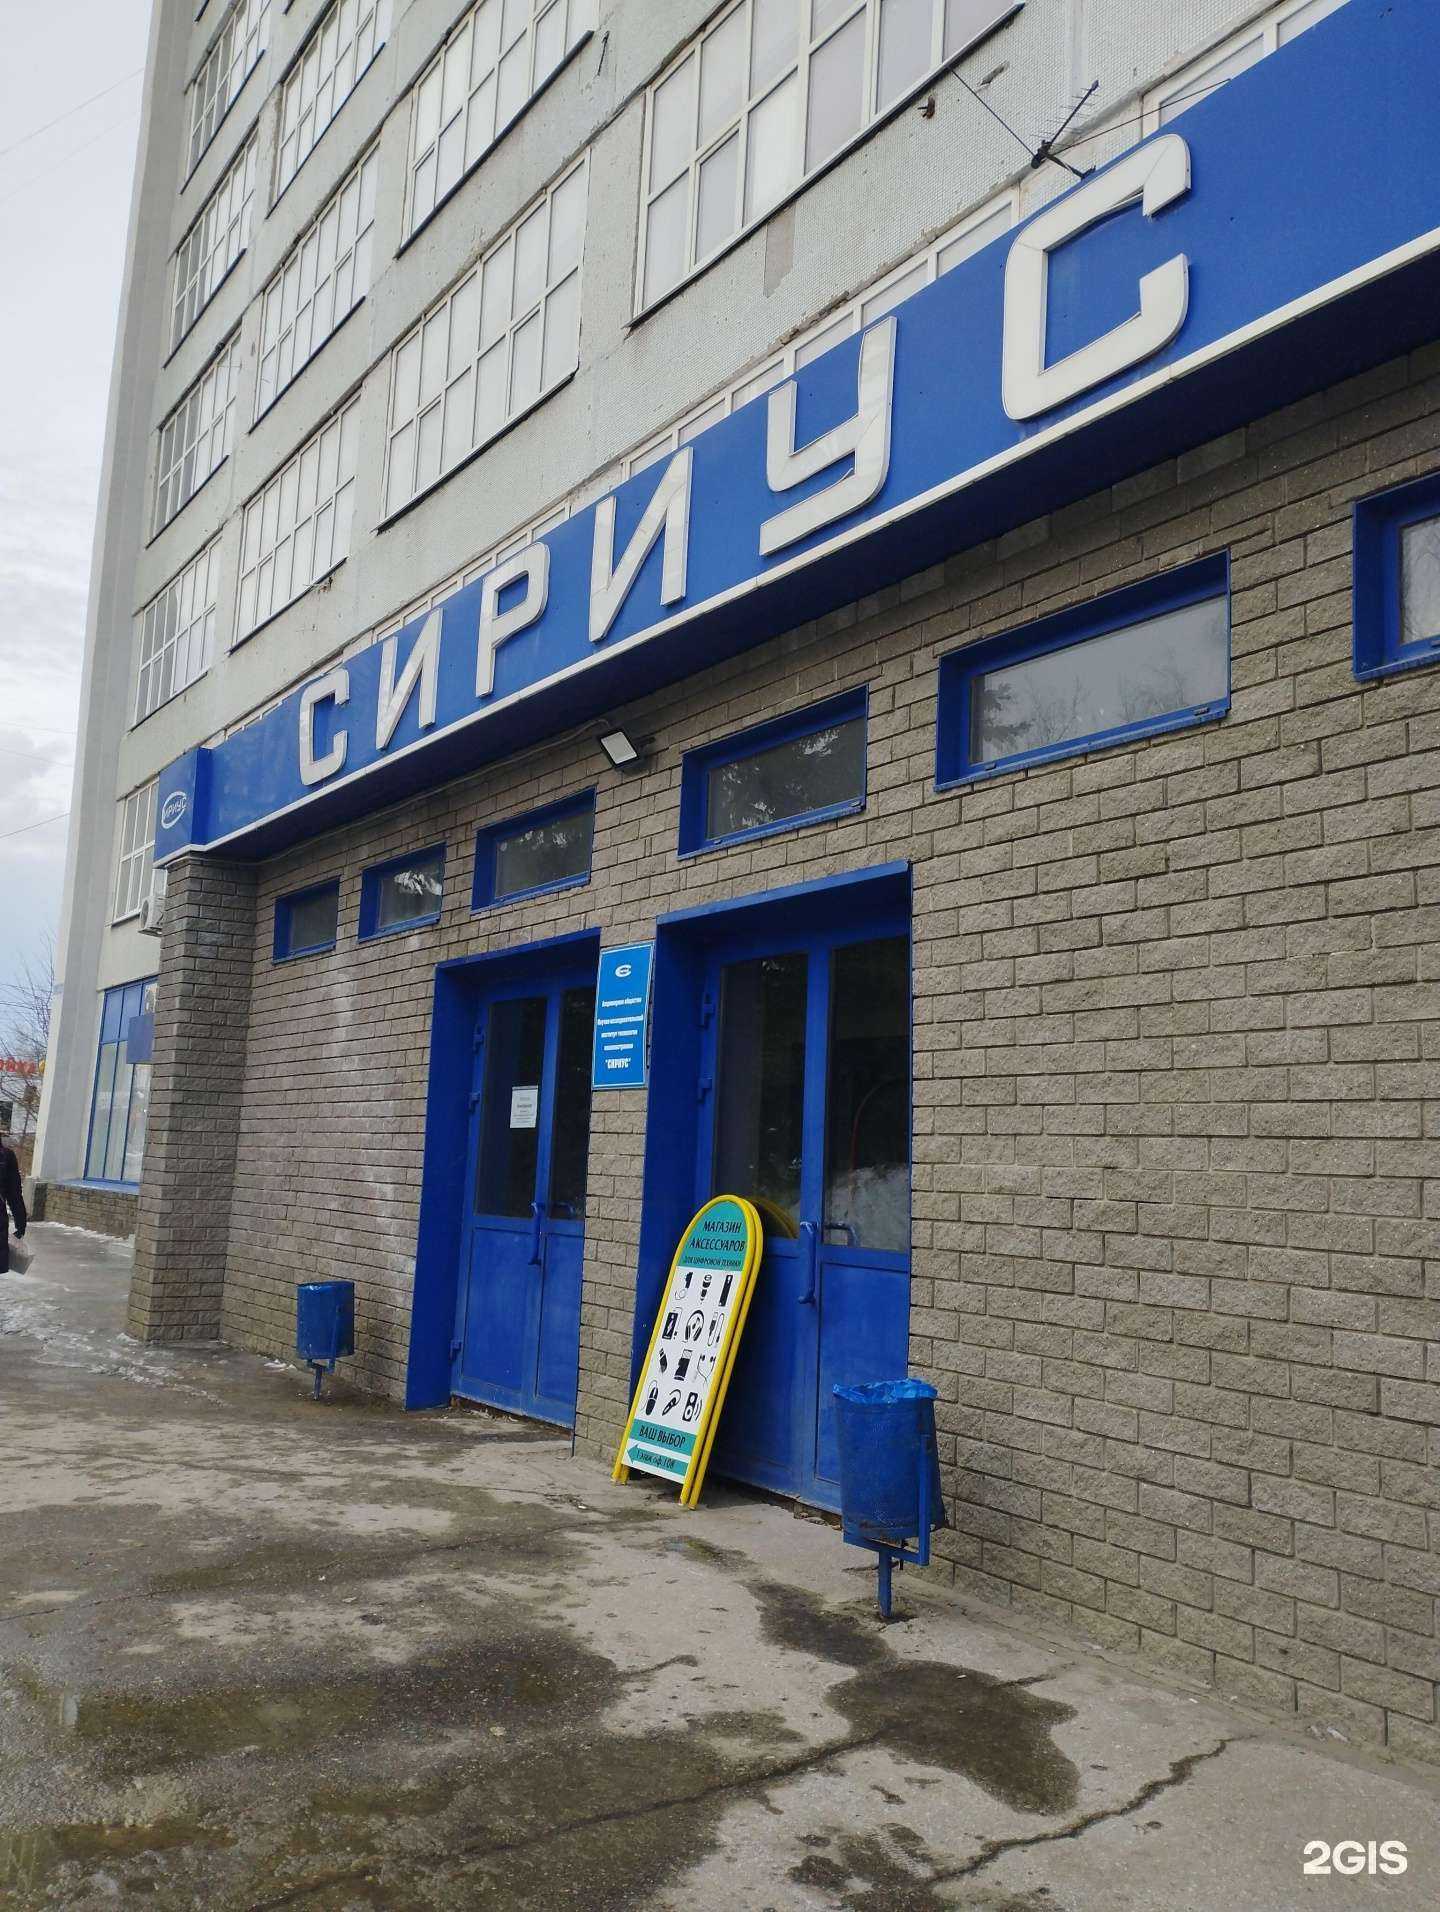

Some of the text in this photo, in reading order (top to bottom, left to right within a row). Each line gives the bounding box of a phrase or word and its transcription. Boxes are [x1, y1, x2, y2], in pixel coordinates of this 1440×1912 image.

[298, 133, 1192, 788] СИРИУС
[703, 1221, 742, 1233] МАГАЗИН
[689, 1238, 746, 1252] АКСЕССУАРОВ
[639, 1424, 686, 1448] ВАШ ВЫБОР
